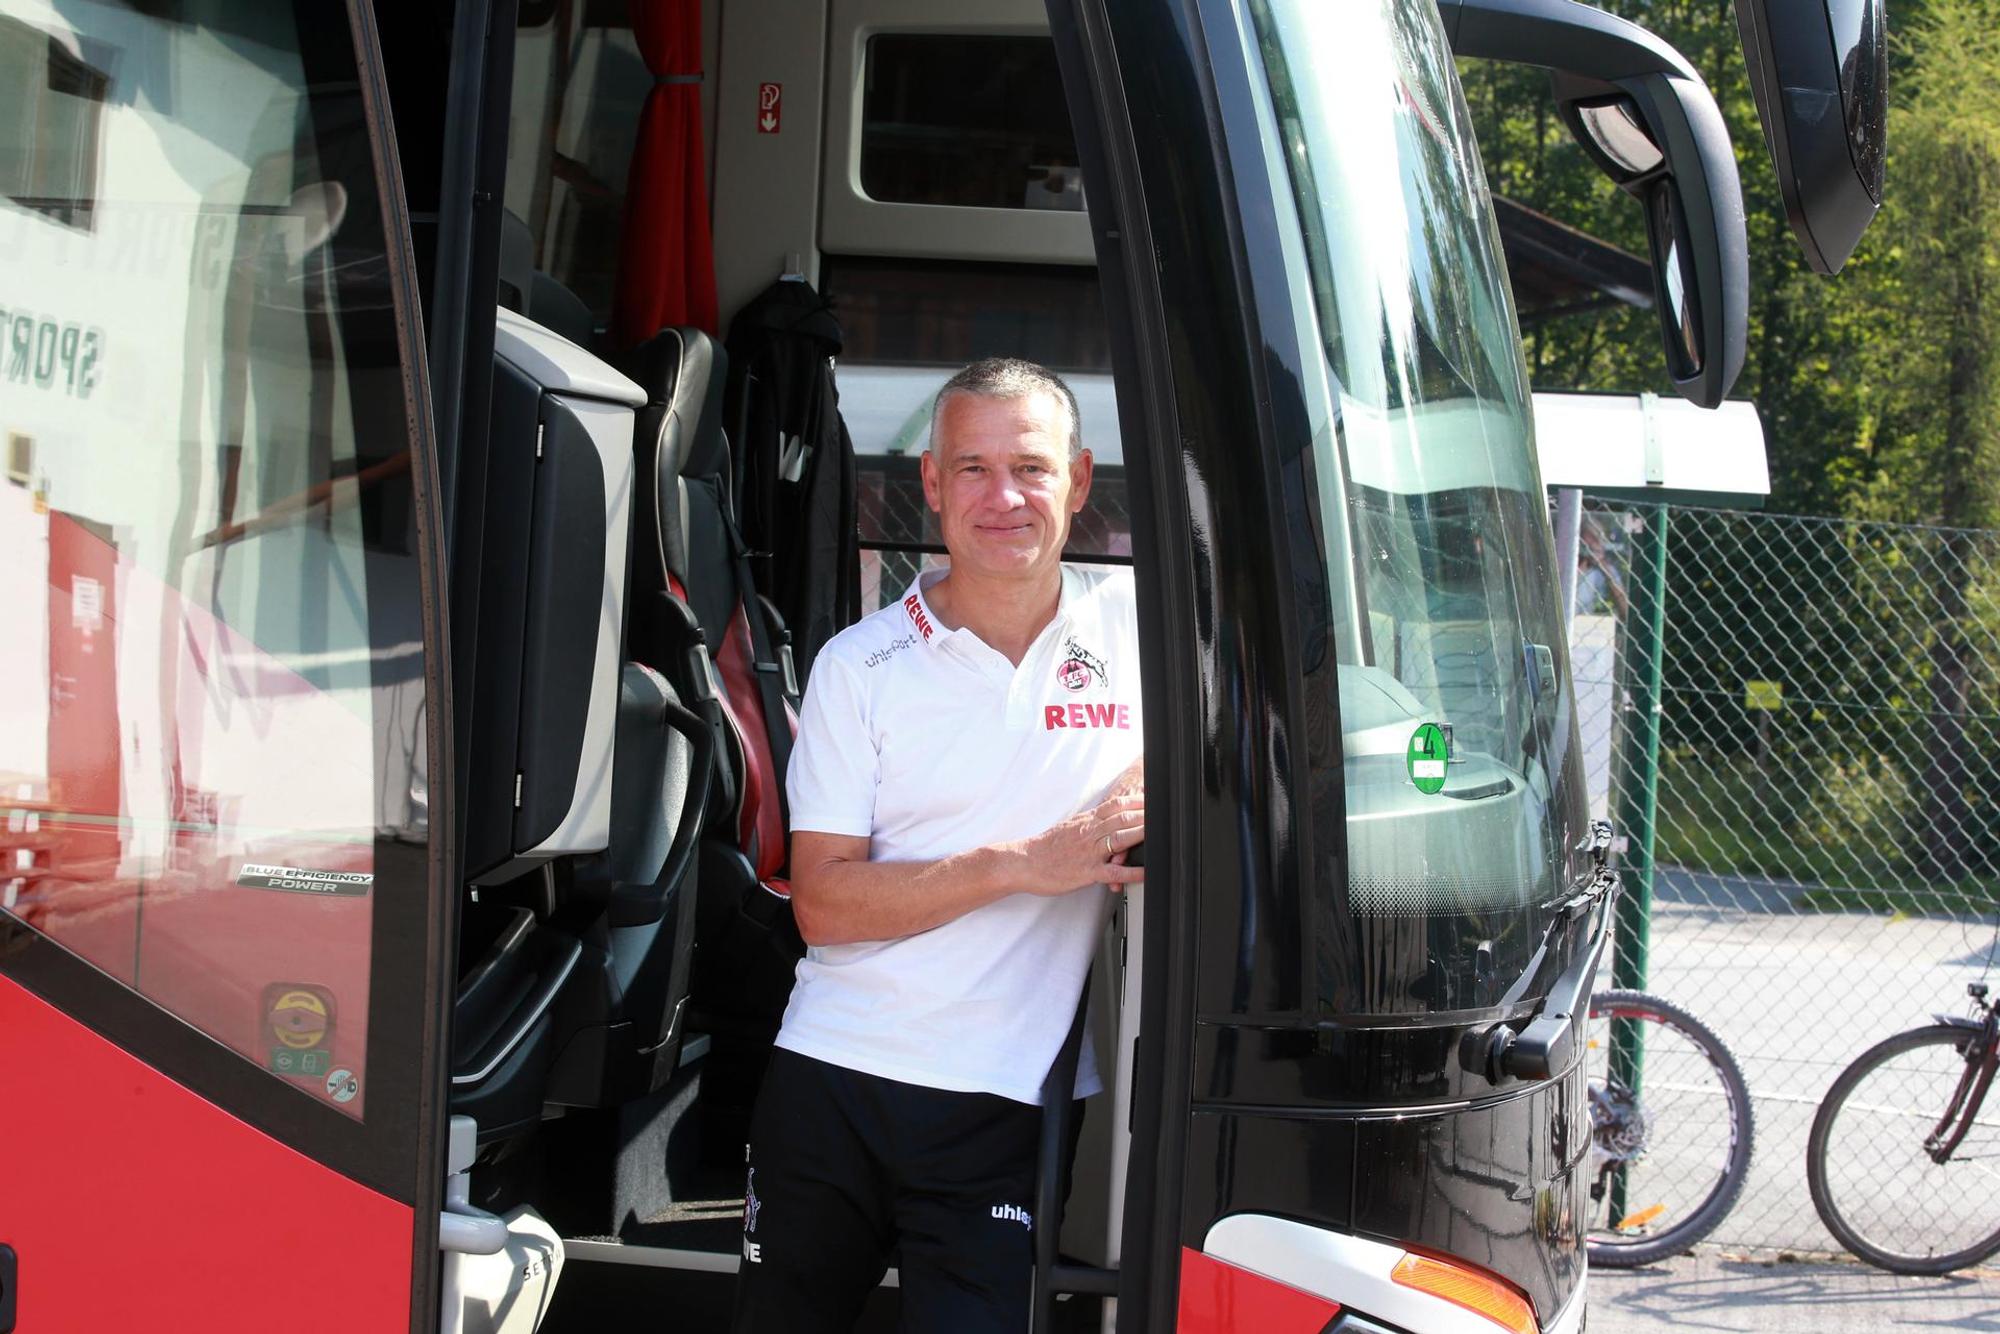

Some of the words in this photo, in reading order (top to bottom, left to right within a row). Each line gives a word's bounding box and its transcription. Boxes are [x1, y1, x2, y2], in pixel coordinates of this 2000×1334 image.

[904, 594, 933, 645] REWE
[865, 634, 917, 668] uhlsport
[1045, 703, 1130, 730] REWE
[1423, 727, 1435, 759] 4
[268, 878, 337, 892] POWER
